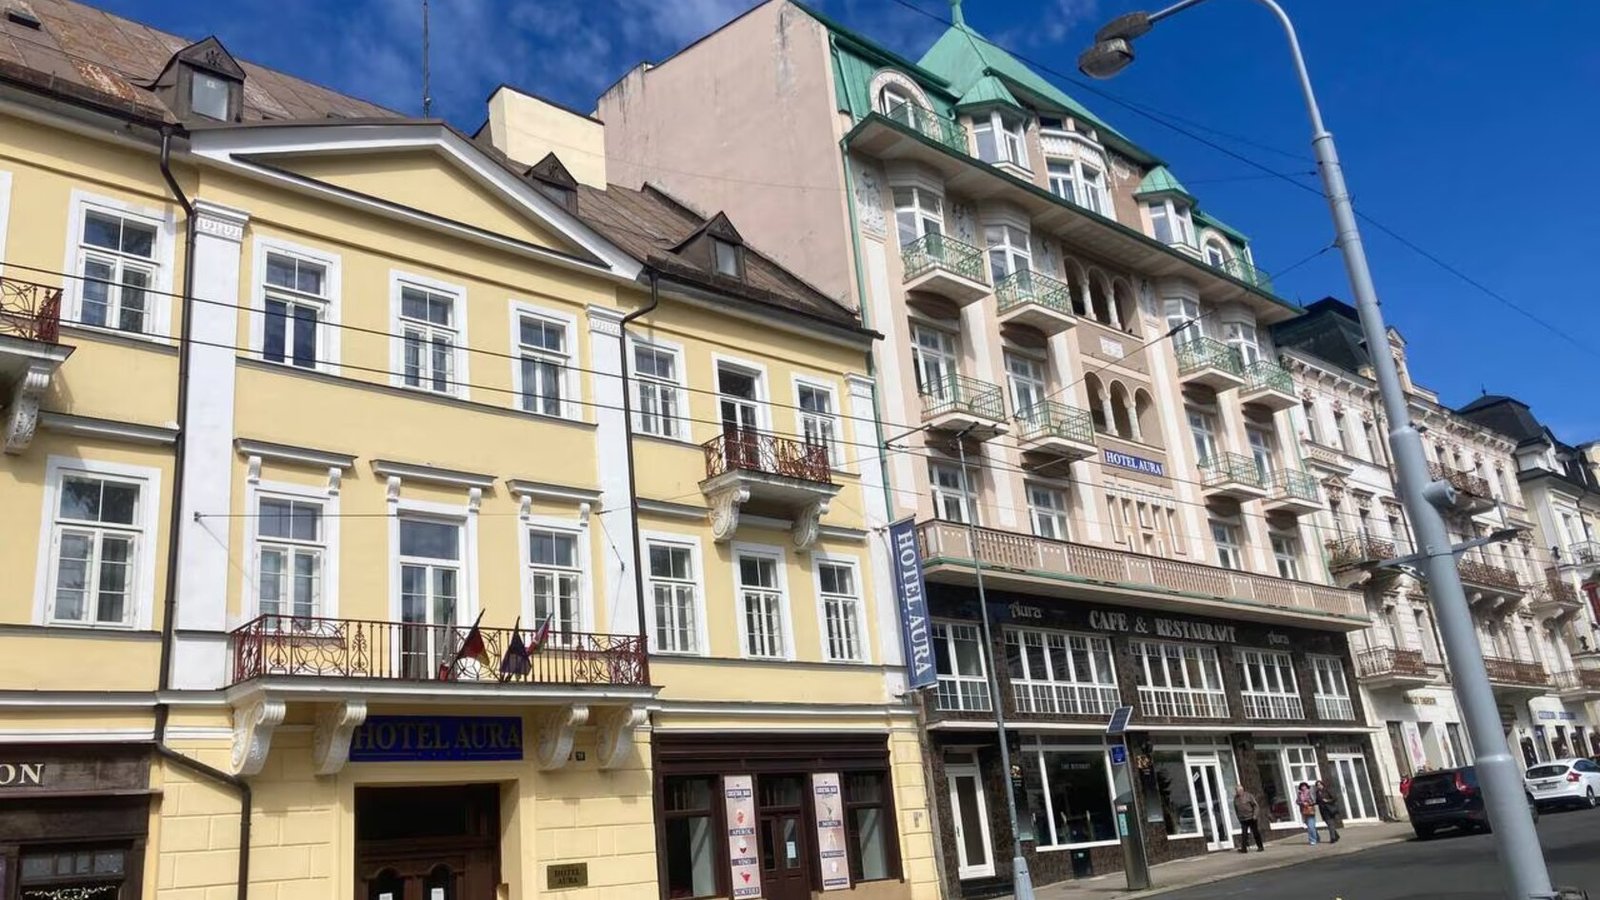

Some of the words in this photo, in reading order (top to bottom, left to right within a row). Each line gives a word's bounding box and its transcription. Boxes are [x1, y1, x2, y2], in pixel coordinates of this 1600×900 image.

[1106, 452, 1138, 468] HOTEL
[1139, 459, 1161, 474] AURA
[898, 529, 922, 611] HOTEL
[1009, 601, 1042, 618] Aura
[1090, 610, 1128, 632] CAFE
[1136, 617, 1148, 633] &
[1156, 619, 1236, 642] RESTAURANT
[909, 613, 932, 676] AURA
[353, 722, 450, 749] HOTEL
[456, 723, 522, 748] AURA
